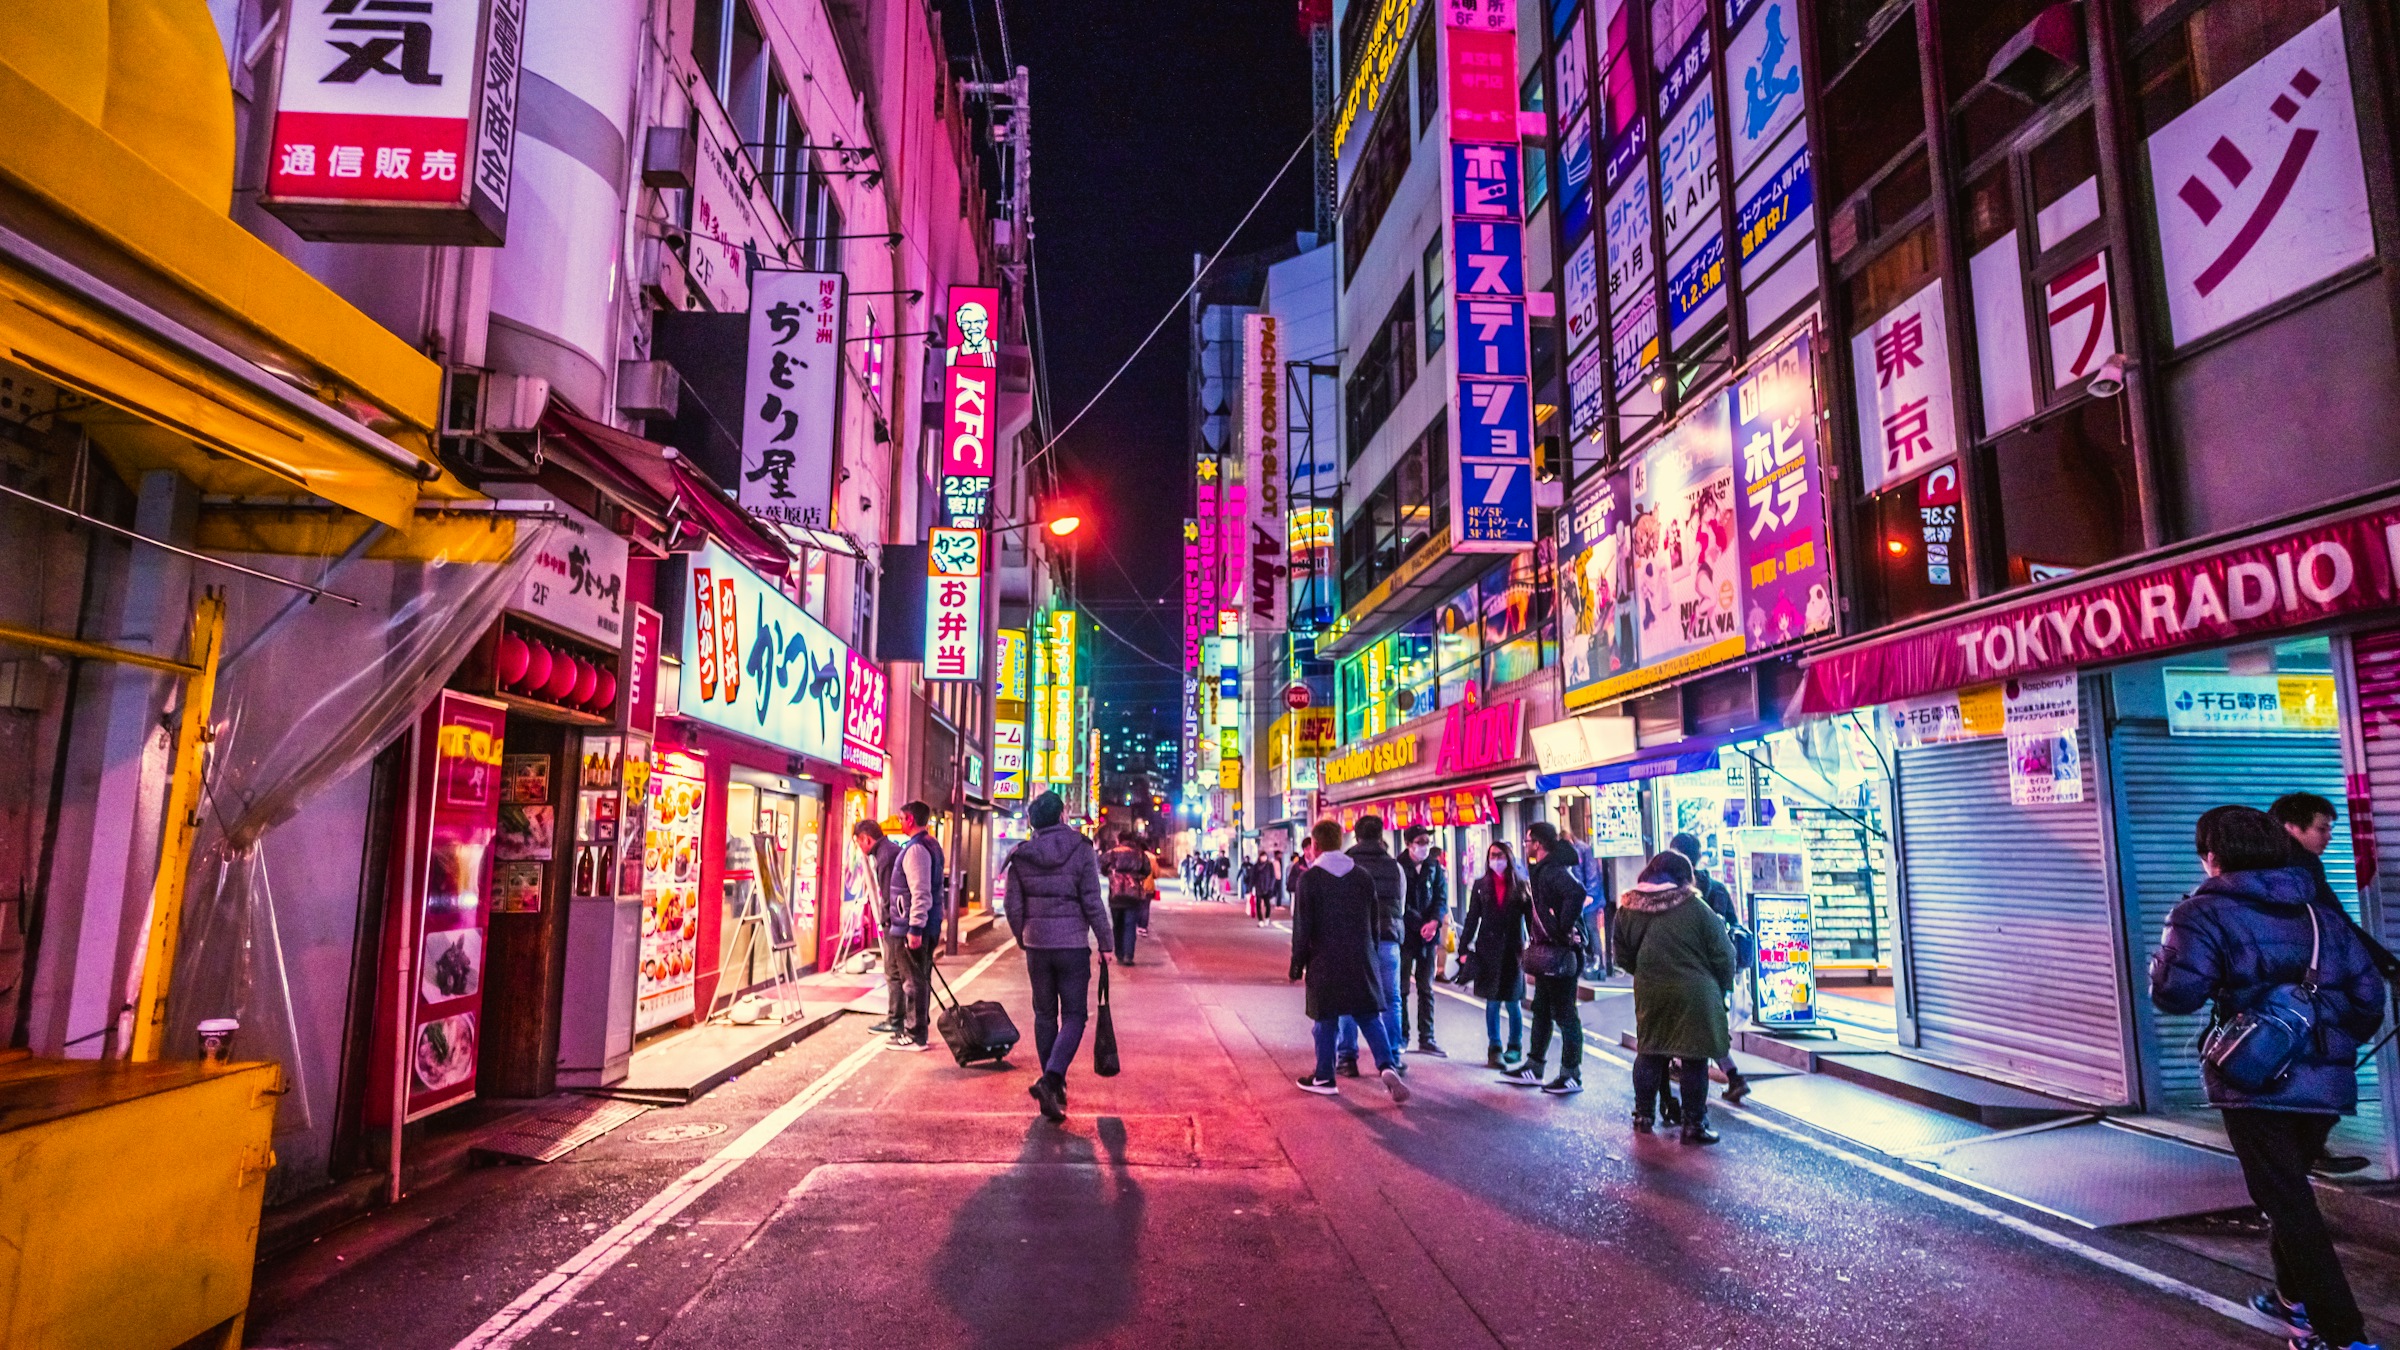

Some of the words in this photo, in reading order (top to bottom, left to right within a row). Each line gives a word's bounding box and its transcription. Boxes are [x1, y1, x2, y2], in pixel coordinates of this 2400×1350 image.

[279, 143, 458, 182] 通信販売
[2178, 66, 2322, 298] ジ
[695, 247, 714, 287] 2F
[816, 279, 835, 344] 博多中洲
[1261, 317, 1277, 433] PACHINKO
[1875, 311, 1934, 472] 東京
[952, 372, 986, 468] KFC
[1261, 454, 1278, 518] SLOT
[532, 581, 550, 606] 2F
[697, 574, 715, 685] とんかつ
[937, 580, 968, 676] お弁当
[1957, 598, 2122, 677] TOKYO
[2139, 541, 2354, 639] RADIO
[722, 586, 739, 687] カツ丼
[746, 592, 841, 746] かつや
[848, 698, 883, 745] とんかつ
[850, 656, 884, 714] カツ丼
[2022, 679, 2064, 691] Raspberry
[2065, 675, 2073, 685] Pi
[2197, 691, 2277, 711] 千石電商
[1185, 679, 1198, 777] ゲームコーナー
[1382, 733, 1416, 770] SLOT
